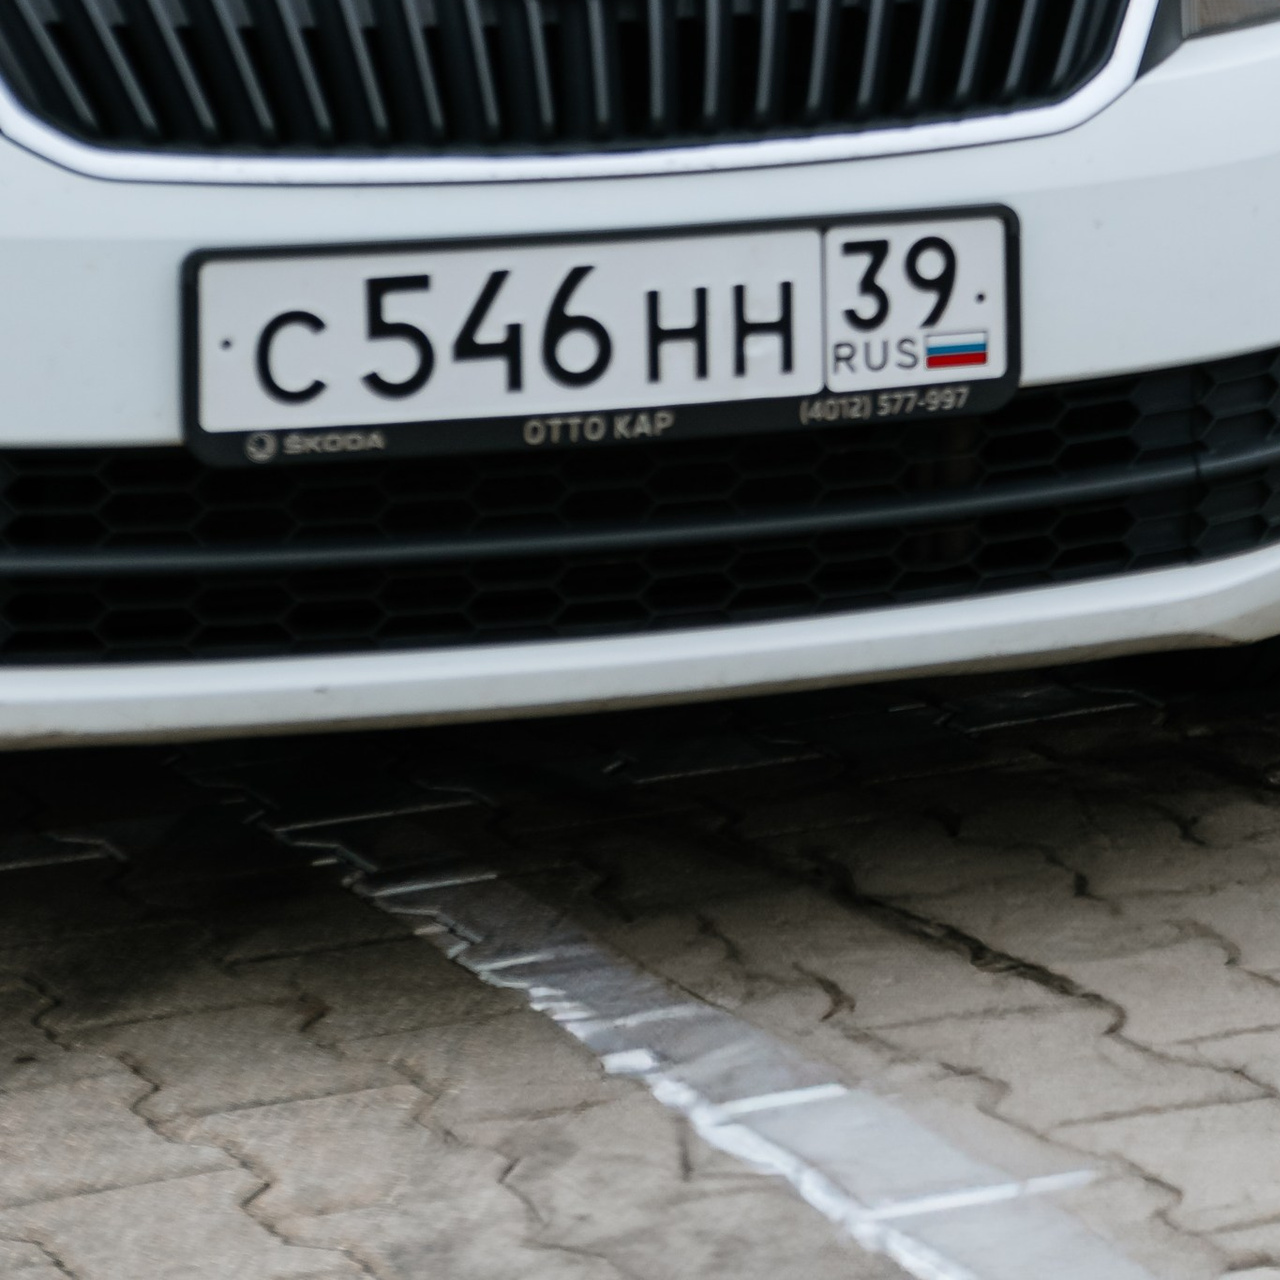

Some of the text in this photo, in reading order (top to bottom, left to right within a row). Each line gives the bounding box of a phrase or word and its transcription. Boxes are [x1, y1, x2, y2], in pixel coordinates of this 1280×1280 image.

[841, 236, 957, 331] 39
[833, 338, 919, 374] RUS
[877, 386, 970, 417] 577-997
[523, 410, 675, 446] ОТТО КАР
